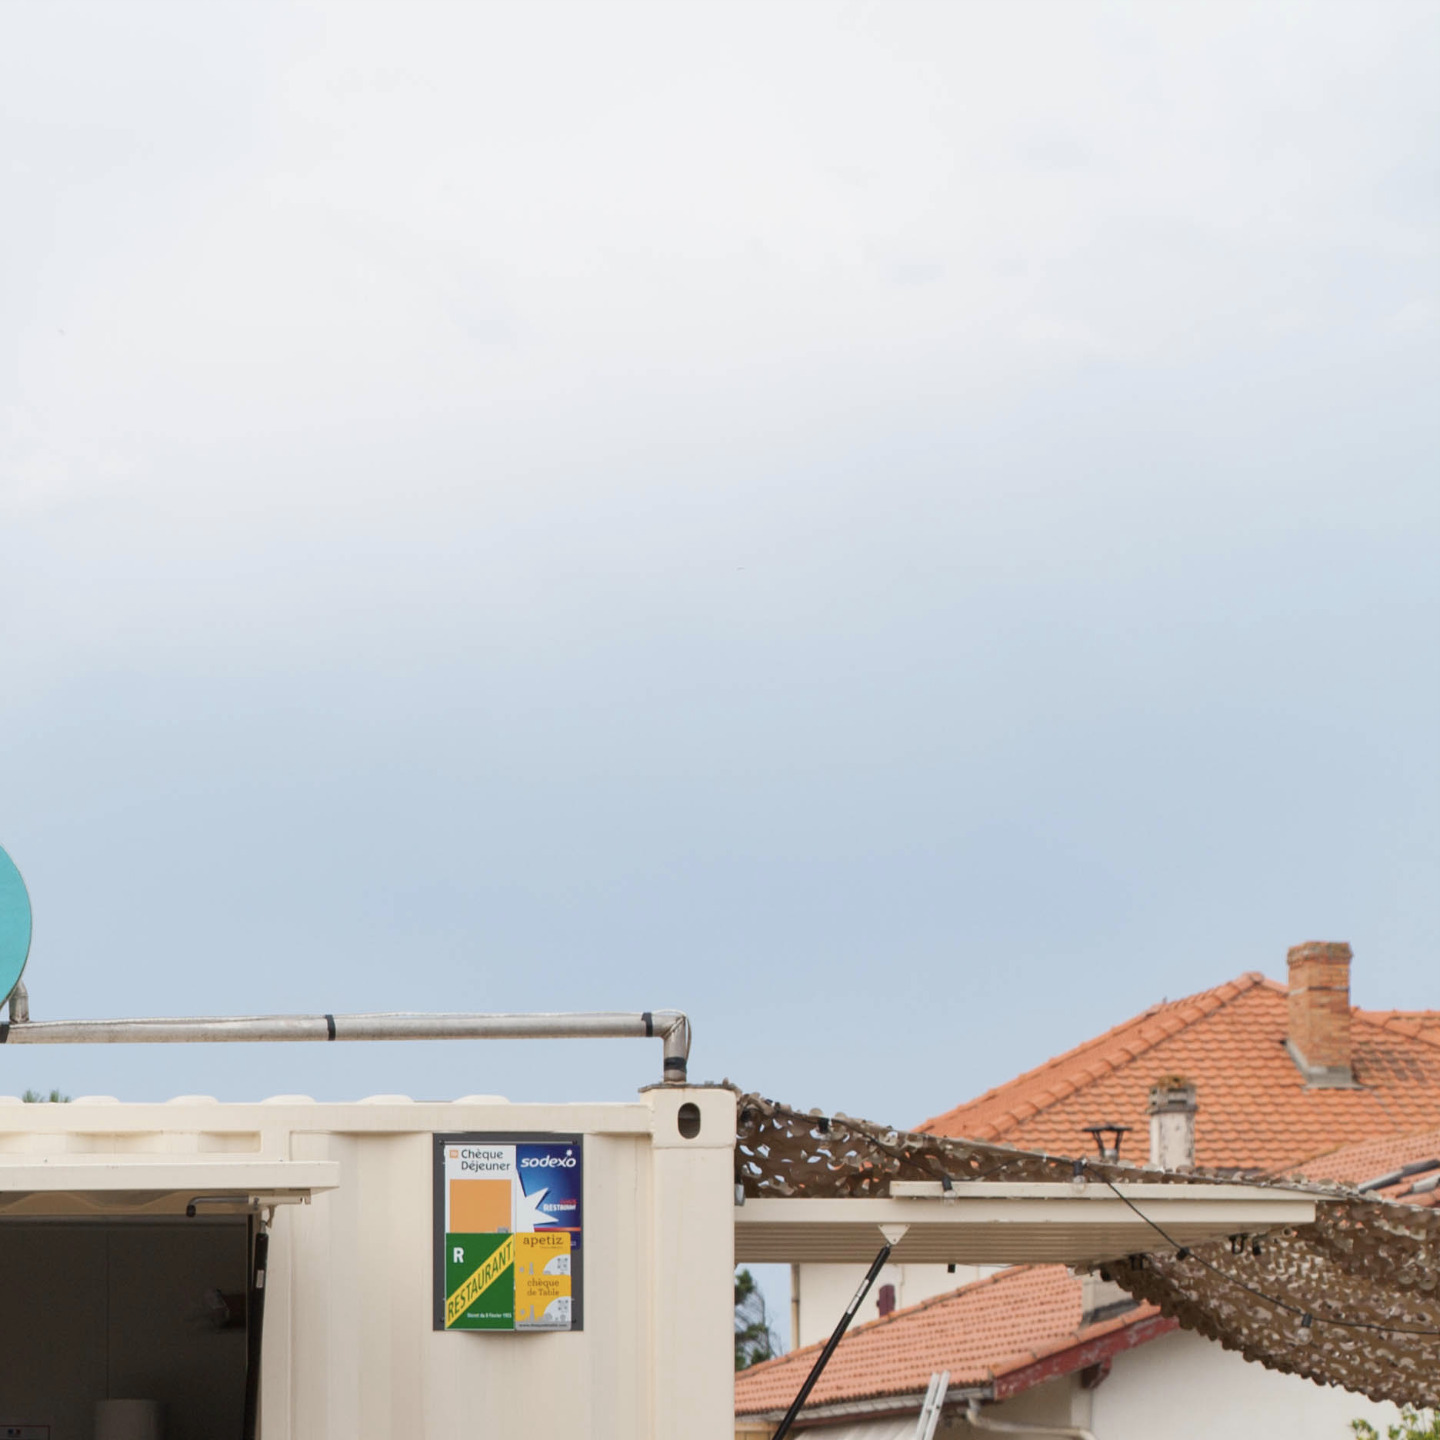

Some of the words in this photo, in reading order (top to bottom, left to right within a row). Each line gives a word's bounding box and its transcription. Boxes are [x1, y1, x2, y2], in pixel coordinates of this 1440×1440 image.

[461, 1149, 504, 1161] Chèque
[520, 1153, 577, 1168] sodexo
[461, 1160, 511, 1173] Déjeuner
[523, 1234, 563, 1247] apetiz
[453, 1247, 464, 1263] R
[447, 1241, 512, 1322] RESTAURANT
[527, 1277, 560, 1289] chèque
[527, 1287, 537, 1296] de
[538, 1287, 560, 1296] Table
